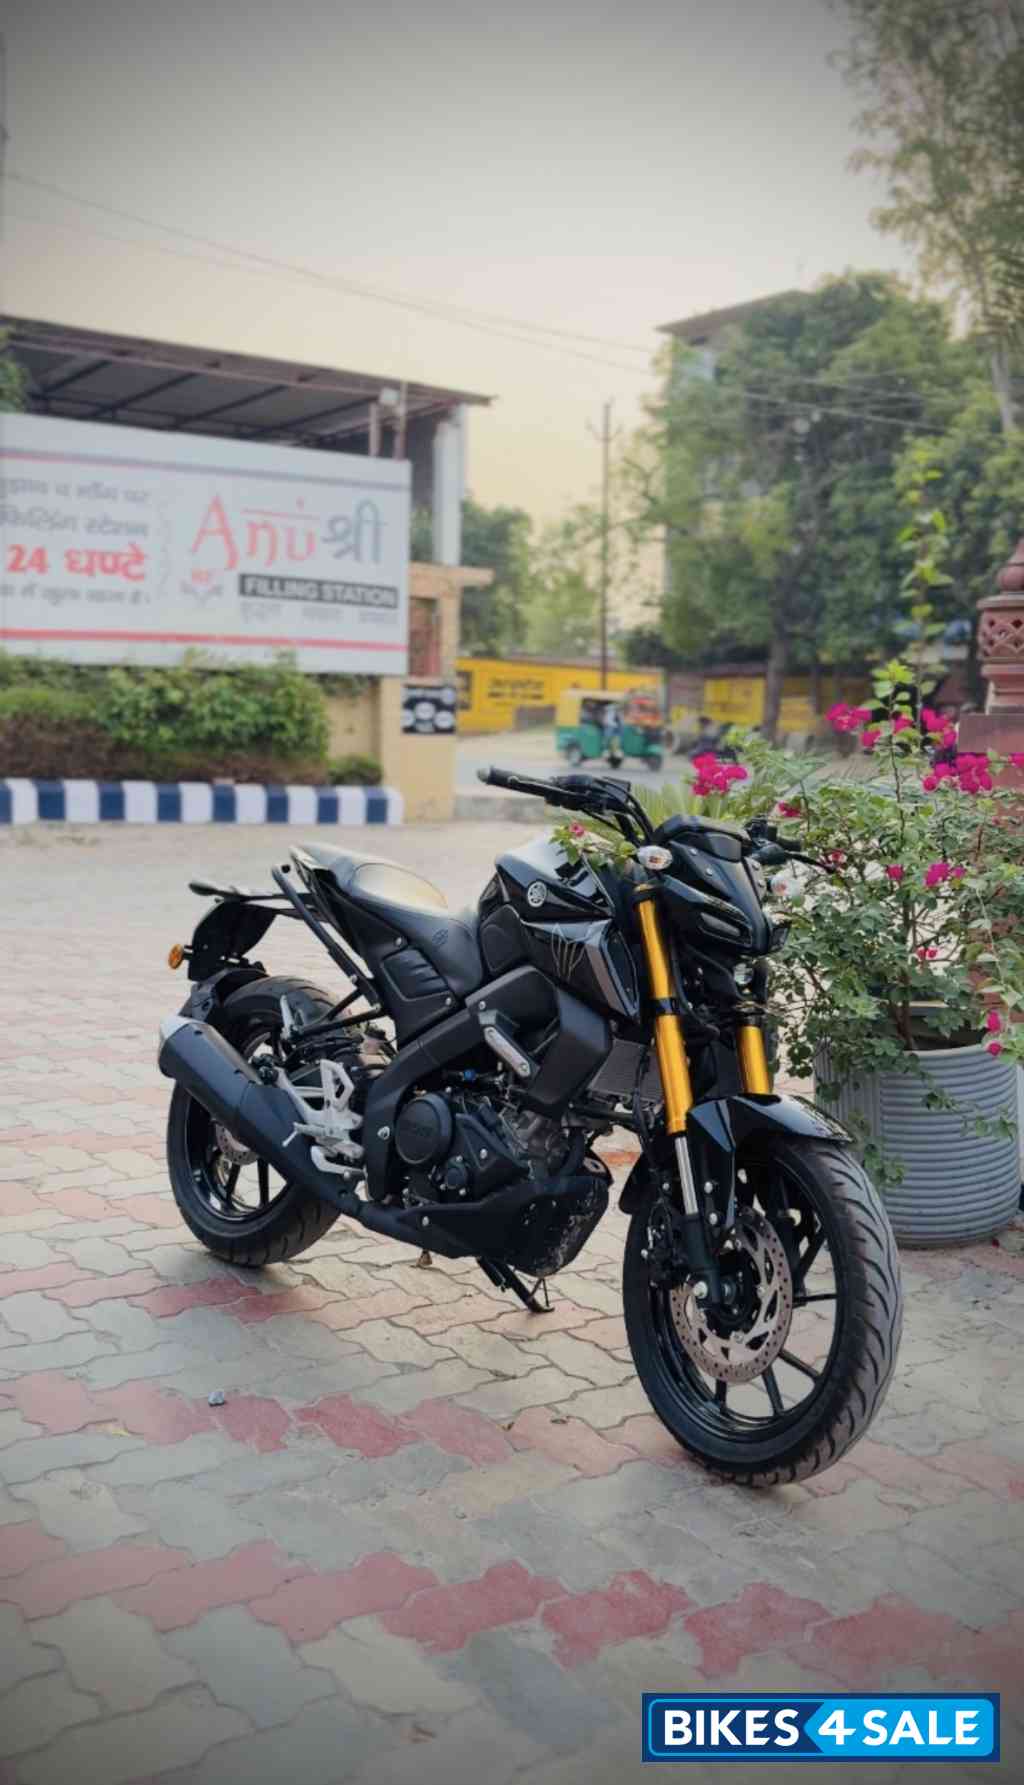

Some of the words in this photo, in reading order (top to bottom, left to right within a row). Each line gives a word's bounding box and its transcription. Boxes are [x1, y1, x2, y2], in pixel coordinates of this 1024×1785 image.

[6, 543, 50, 576] 24
[245, 576, 319, 599] FILLING
[322, 583, 396, 605] STATION
